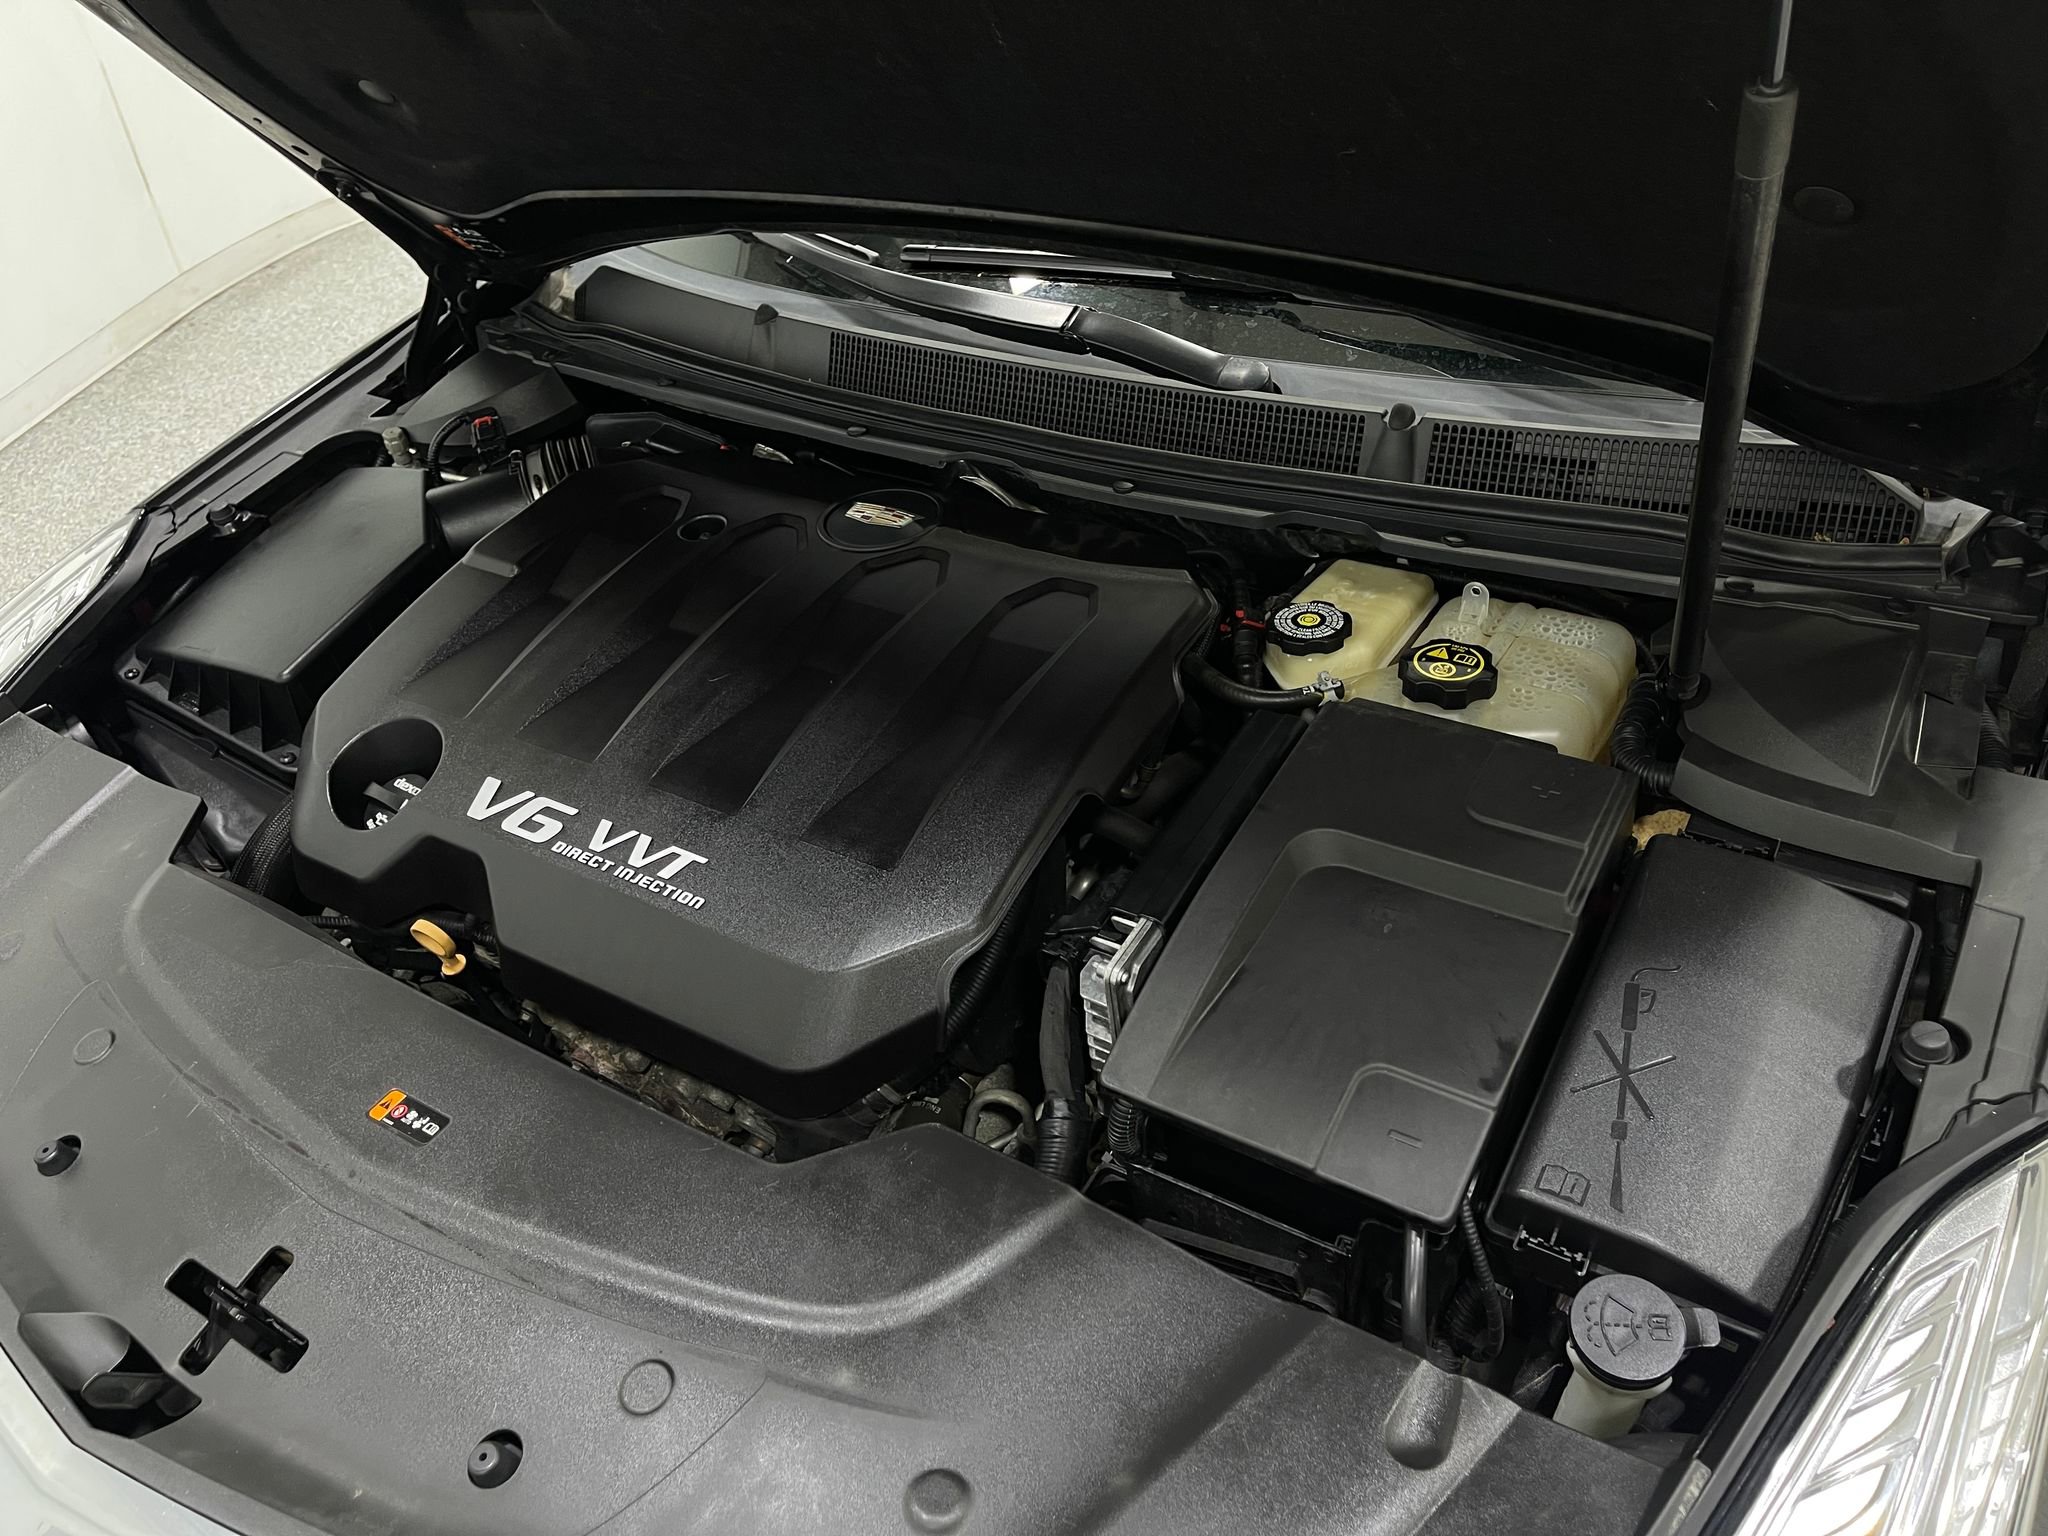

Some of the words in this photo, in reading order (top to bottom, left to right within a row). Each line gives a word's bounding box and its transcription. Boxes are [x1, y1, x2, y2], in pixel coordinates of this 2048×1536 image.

[393, 777, 422, 796] dexo
[466, 775, 580, 844] V6
[588, 818, 709, 880] VVT
[550, 840, 616, 873] DIRECT
[613, 864, 706, 910] INJECTION
